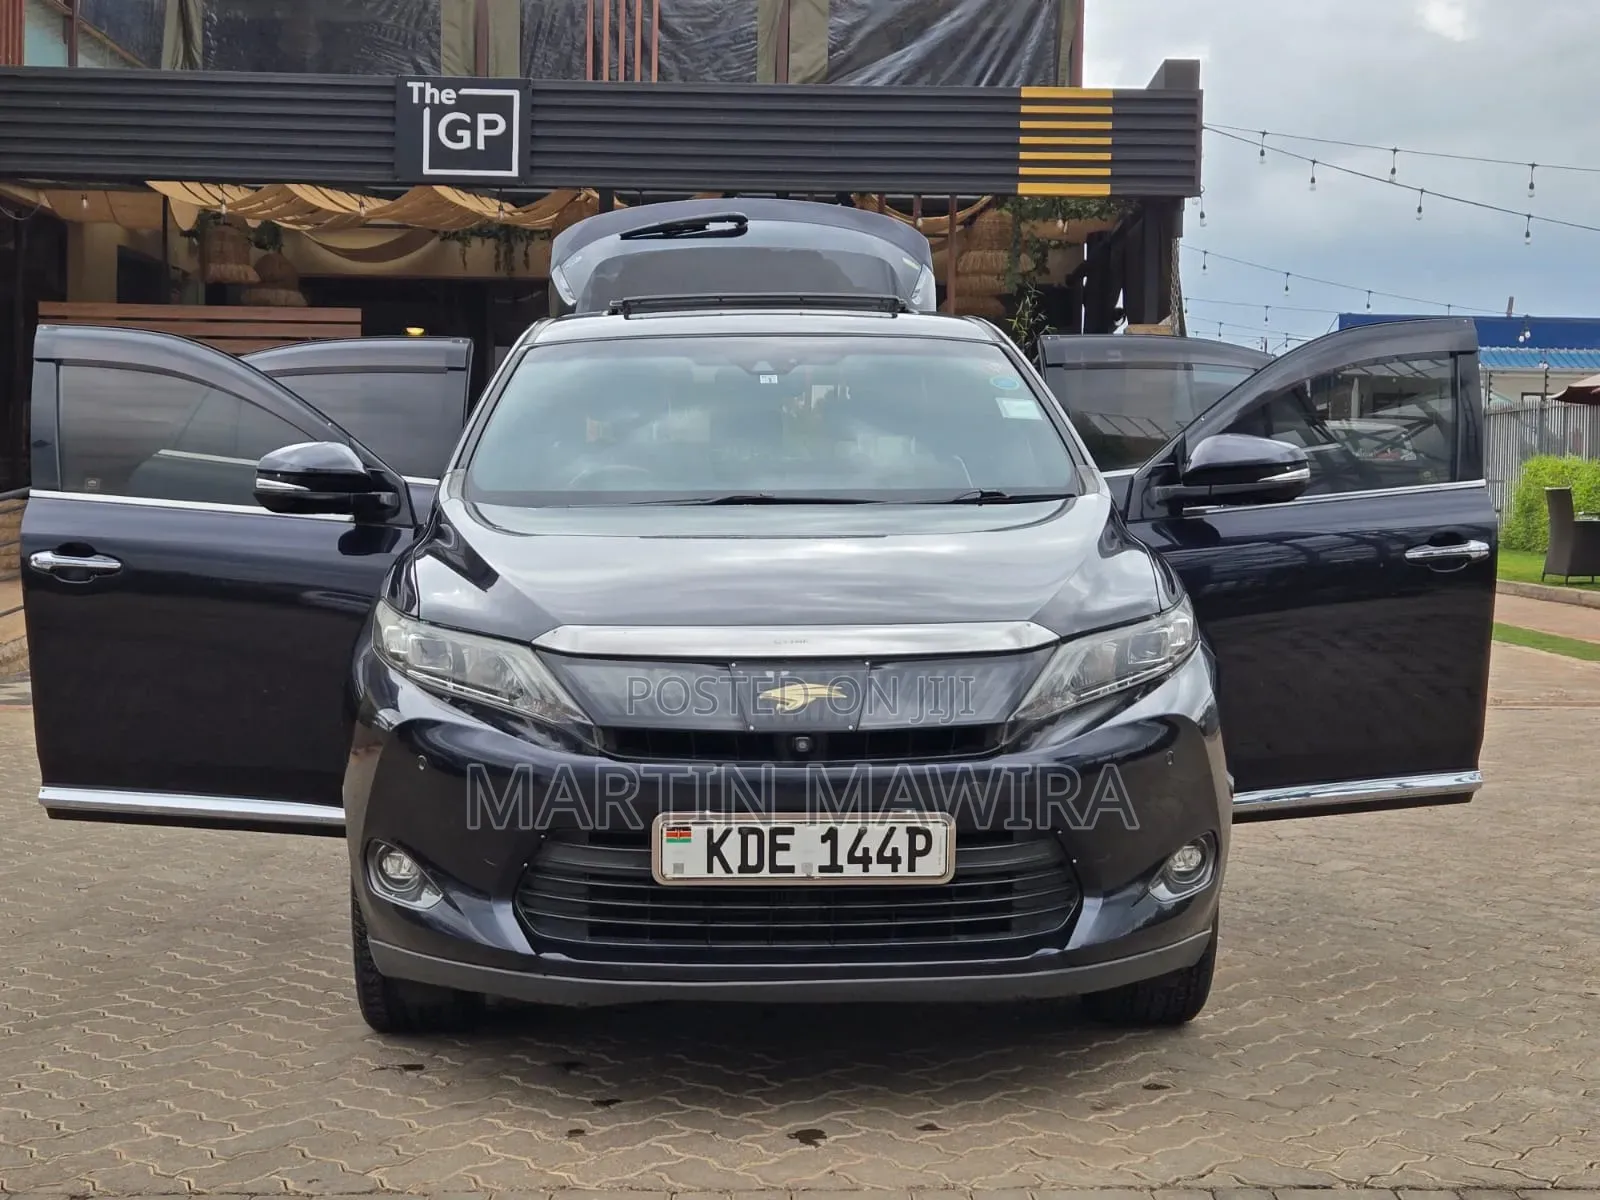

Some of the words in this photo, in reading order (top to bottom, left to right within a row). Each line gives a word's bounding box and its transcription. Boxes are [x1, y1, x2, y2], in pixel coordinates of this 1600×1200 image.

[407, 81, 457, 105] The
[437, 111, 507, 150] GP
[706, 826, 796, 874] KDE
[818, 826, 933, 873] 144P
